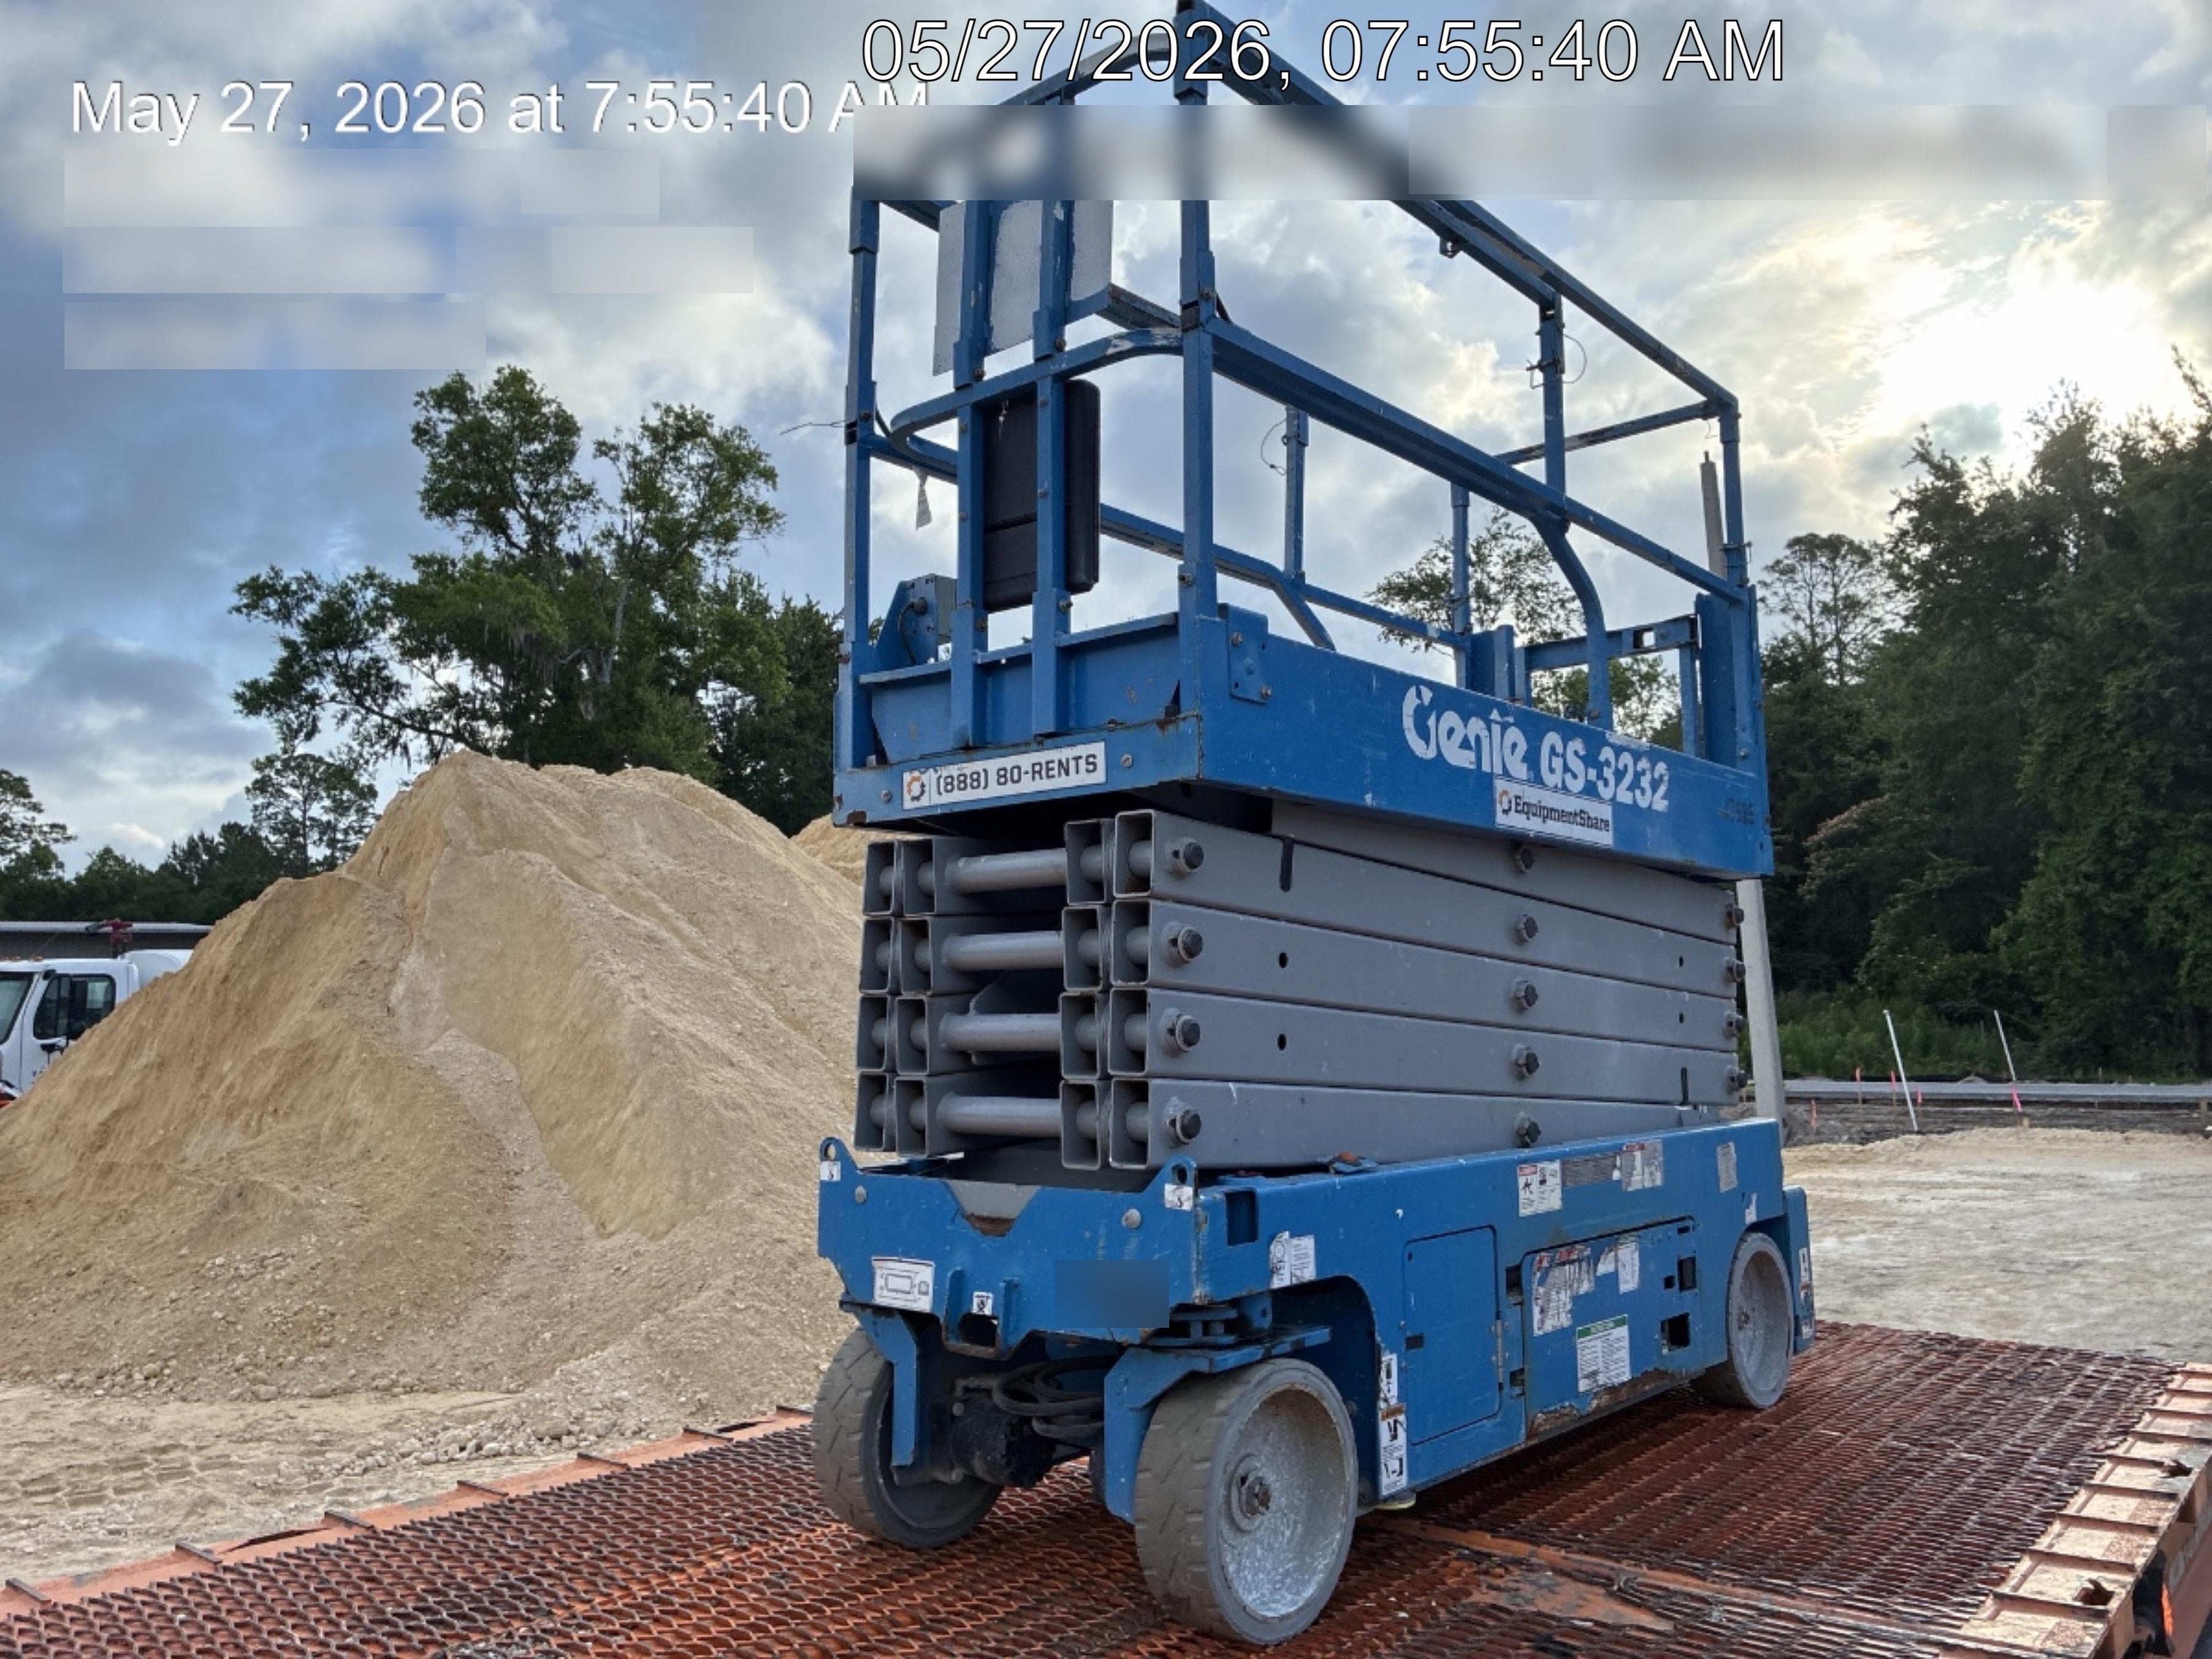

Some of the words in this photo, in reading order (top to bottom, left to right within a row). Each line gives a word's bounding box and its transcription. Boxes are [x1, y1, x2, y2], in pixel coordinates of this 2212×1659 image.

[1402, 684, 1529, 780] Genie
[936, 768, 988, 796] (888)
[997, 754, 1098, 786] 80-RENTS
[1540, 731, 1669, 812] GS-3232
[1515, 794, 1610, 832] EquipmentShare
